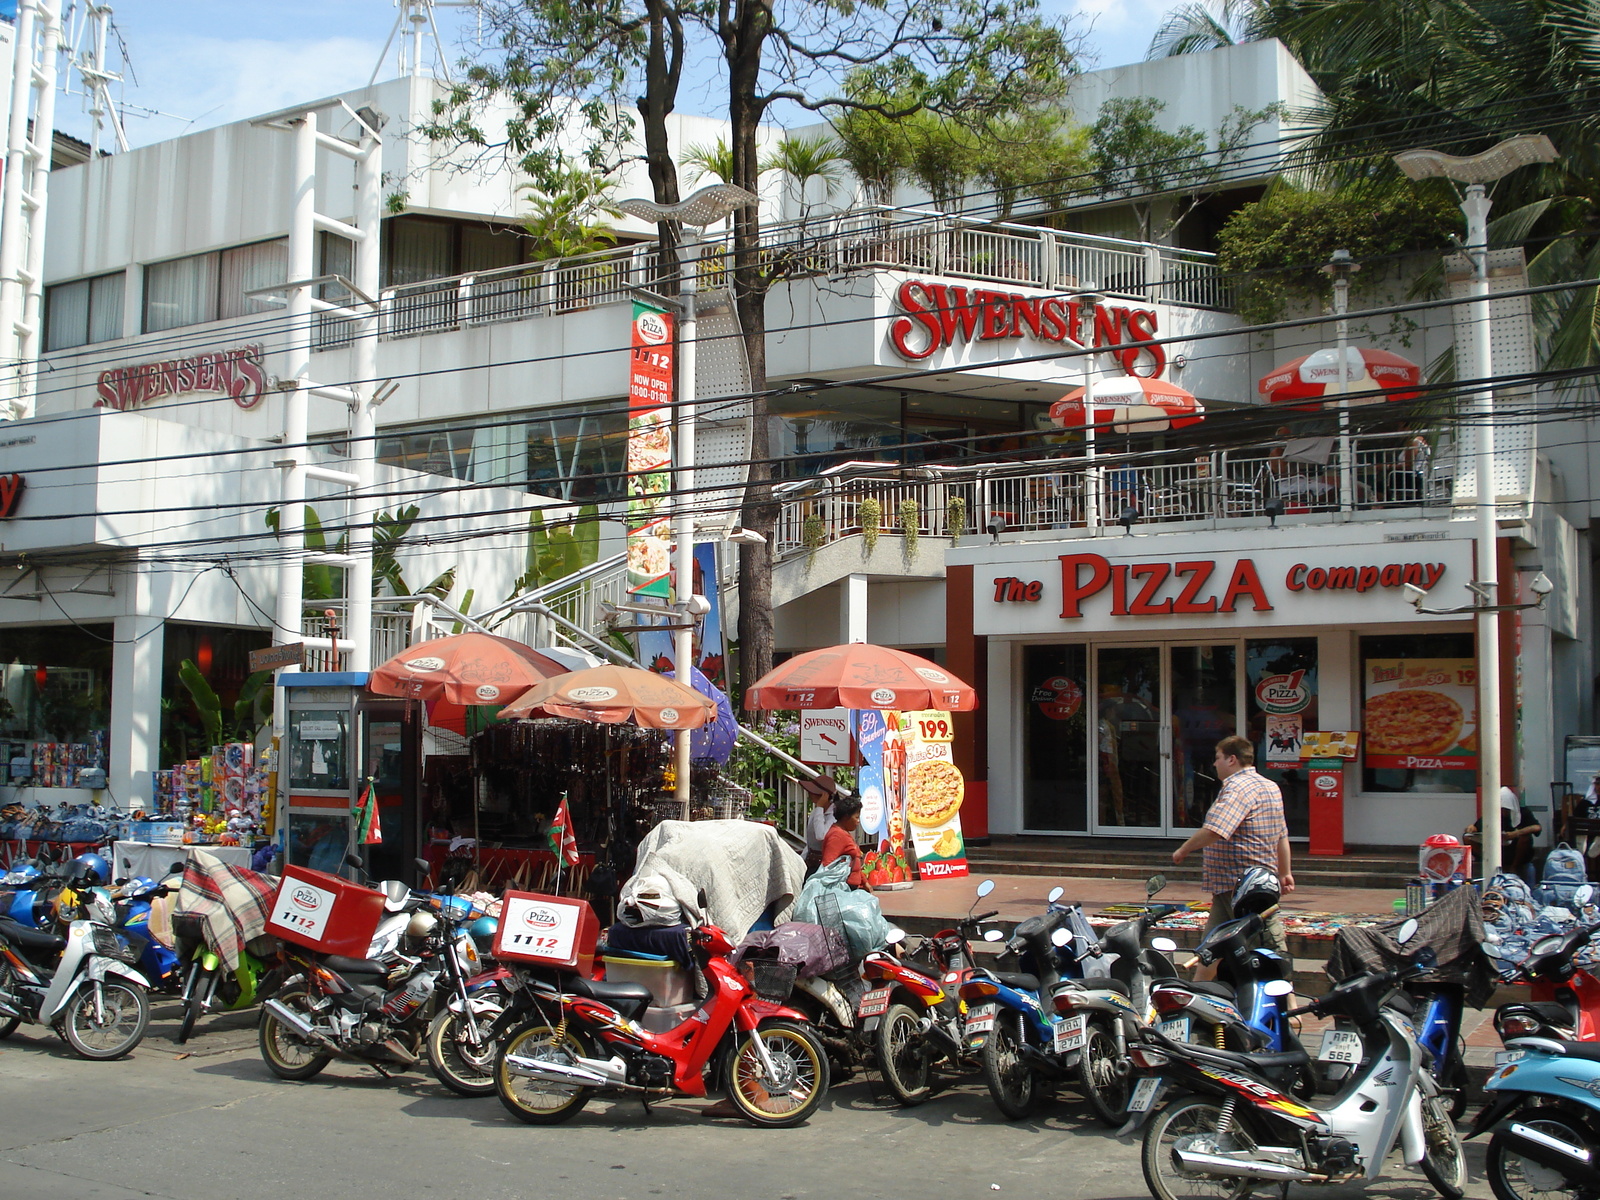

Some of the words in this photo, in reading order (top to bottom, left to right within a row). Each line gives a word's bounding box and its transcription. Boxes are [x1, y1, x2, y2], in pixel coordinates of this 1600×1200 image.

[642, 318, 663, 334] PIZZA
[888, 279, 1166, 379] SWENSEN'S
[635, 347, 670, 369] 1112
[93, 343, 267, 410] SWENSEN'S
[634, 374, 649, 386] NOW
[651, 379, 668, 391] OPEN
[993, 577, 1043, 602] The
[1058, 553, 1274, 618] PIZZA
[1285, 562, 1446, 593] Company
[480, 688, 496, 696] PIZZA
[577, 689, 610, 697] PIZZA
[785, 693, 815, 702] 1112
[1033, 688, 1052, 697] Free
[1269, 689, 1298, 698] PIZZA
[942, 695, 960, 703] 1112
[804, 718, 845, 731] SWENSEN'S
[918, 720, 953, 738] 199.-
[1407, 757, 1443, 768] PIZZA
[926, 863, 952, 876] PIZZA
[297, 890, 317, 904] PIZZA
[283, 912, 315, 929] 1112
[530, 911, 555, 923] PIZZA
[514, 934, 558, 949] 1112
[968, 1022, 986, 1032] 271
[1061, 1036, 1080, 1048] 274
[1328, 1051, 1352, 1061] 562
